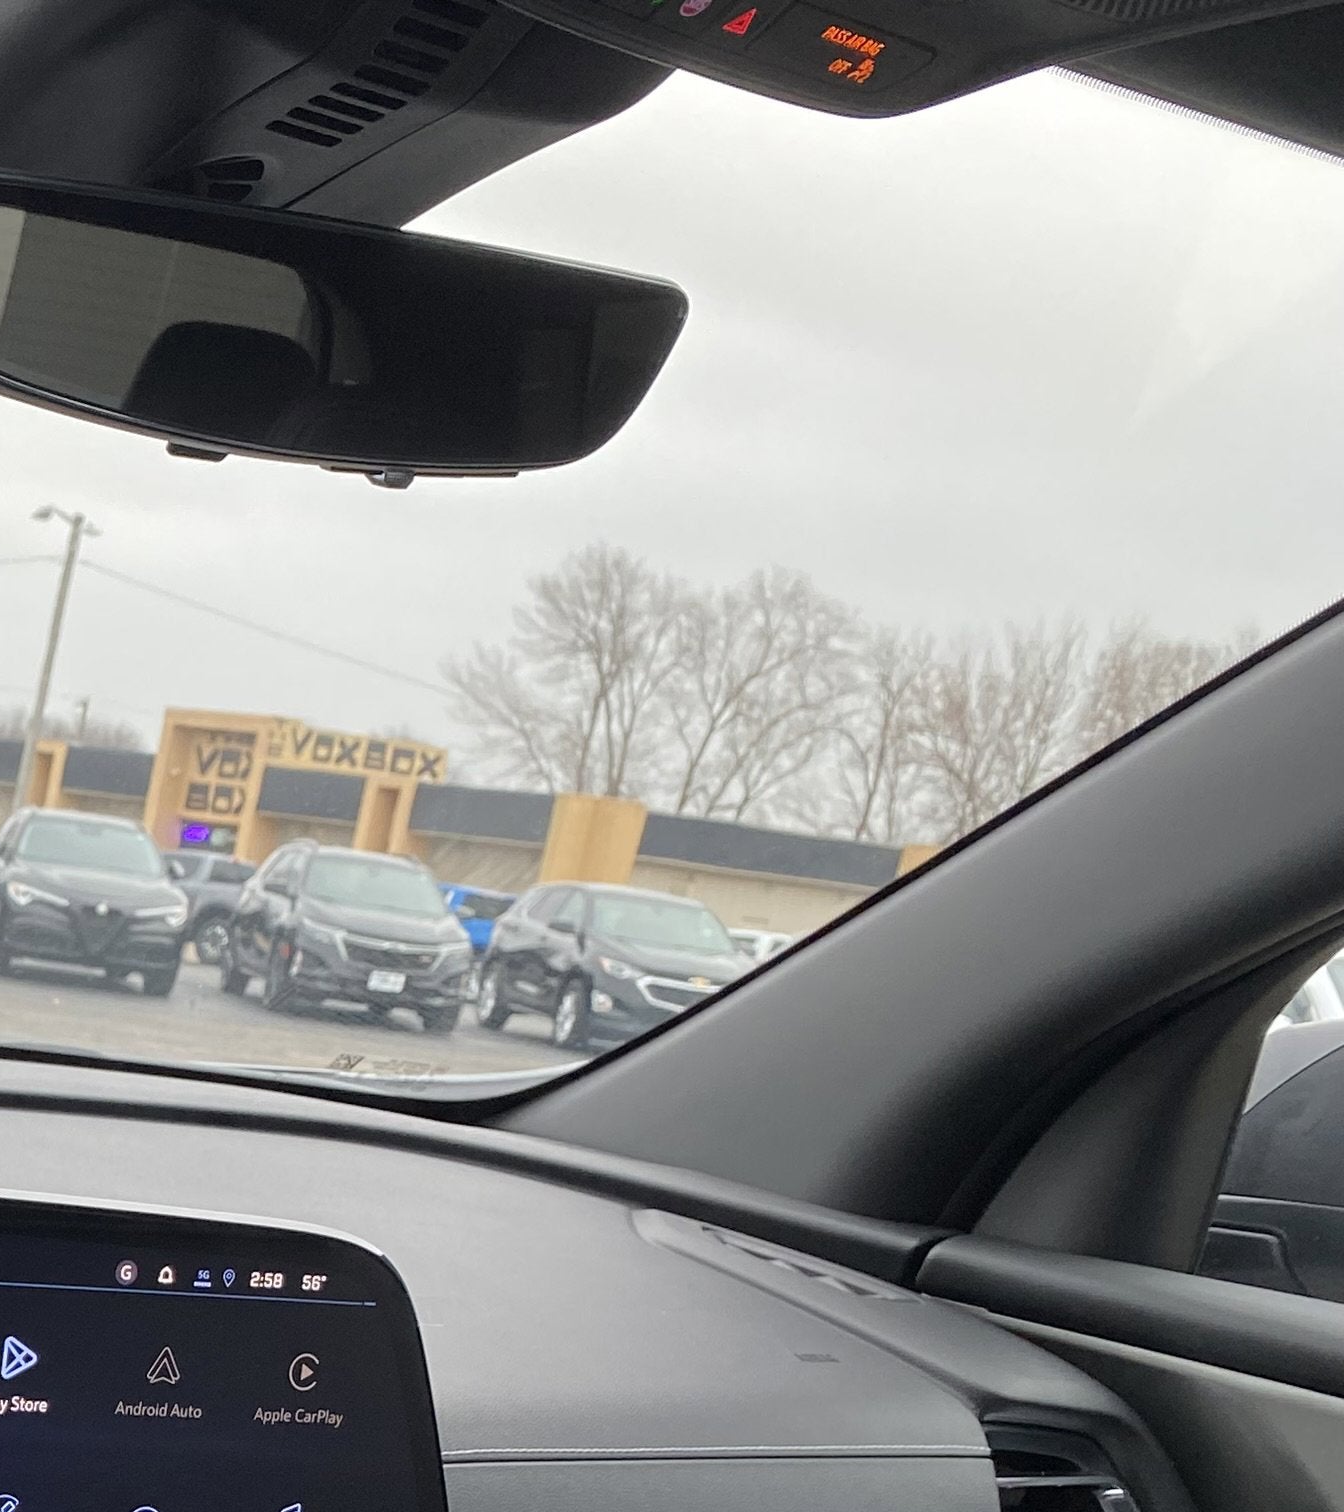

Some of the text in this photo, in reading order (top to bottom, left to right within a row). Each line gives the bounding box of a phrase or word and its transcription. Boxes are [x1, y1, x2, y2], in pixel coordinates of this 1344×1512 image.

[120, 1265, 132, 1281] G
[197, 1269, 210, 1280] 5G
[249, 1271, 327, 1291] 2:58 56°
[10, 1396, 48, 1413] Store
[114, 1400, 203, 1419] Android Auto
[253, 1407, 344, 1428] Apple CarPlay
